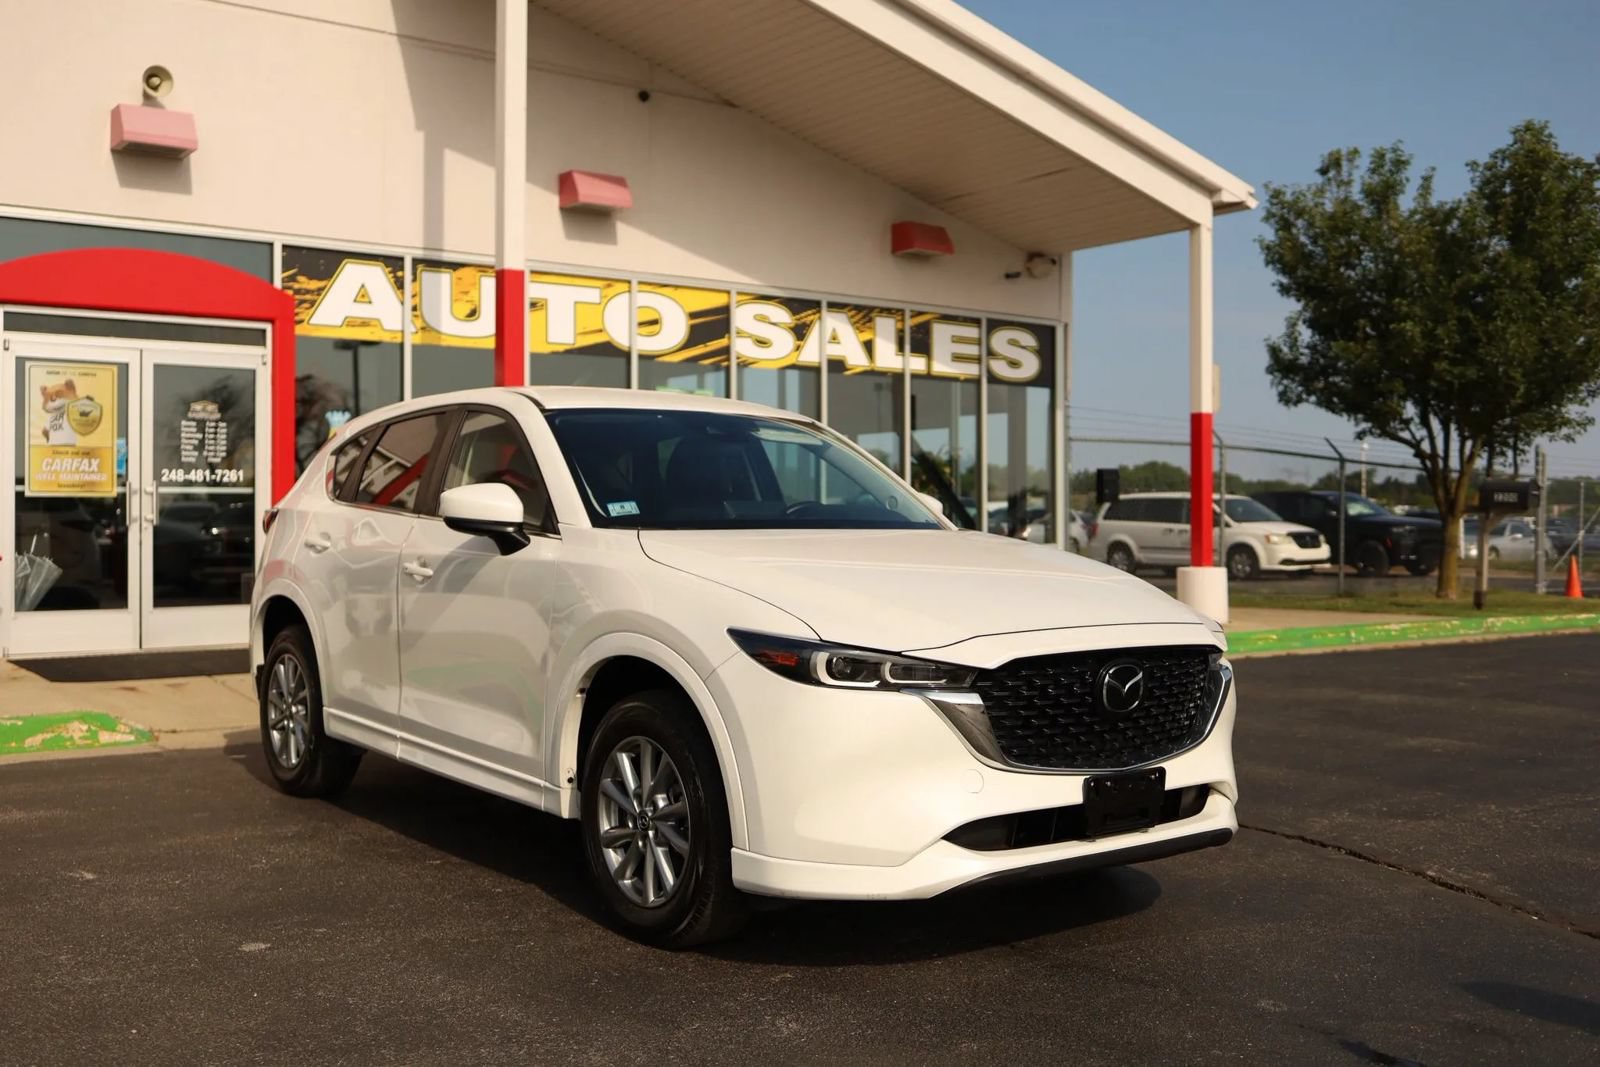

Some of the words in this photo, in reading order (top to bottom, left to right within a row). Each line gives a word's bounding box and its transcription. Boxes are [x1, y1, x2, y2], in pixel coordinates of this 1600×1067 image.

[306, 258, 690, 356] AUTO
[734, 300, 1042, 382] SALES
[42, 457, 100, 472] CARFAX
[160, 468, 244, 483] 248-481-7261
